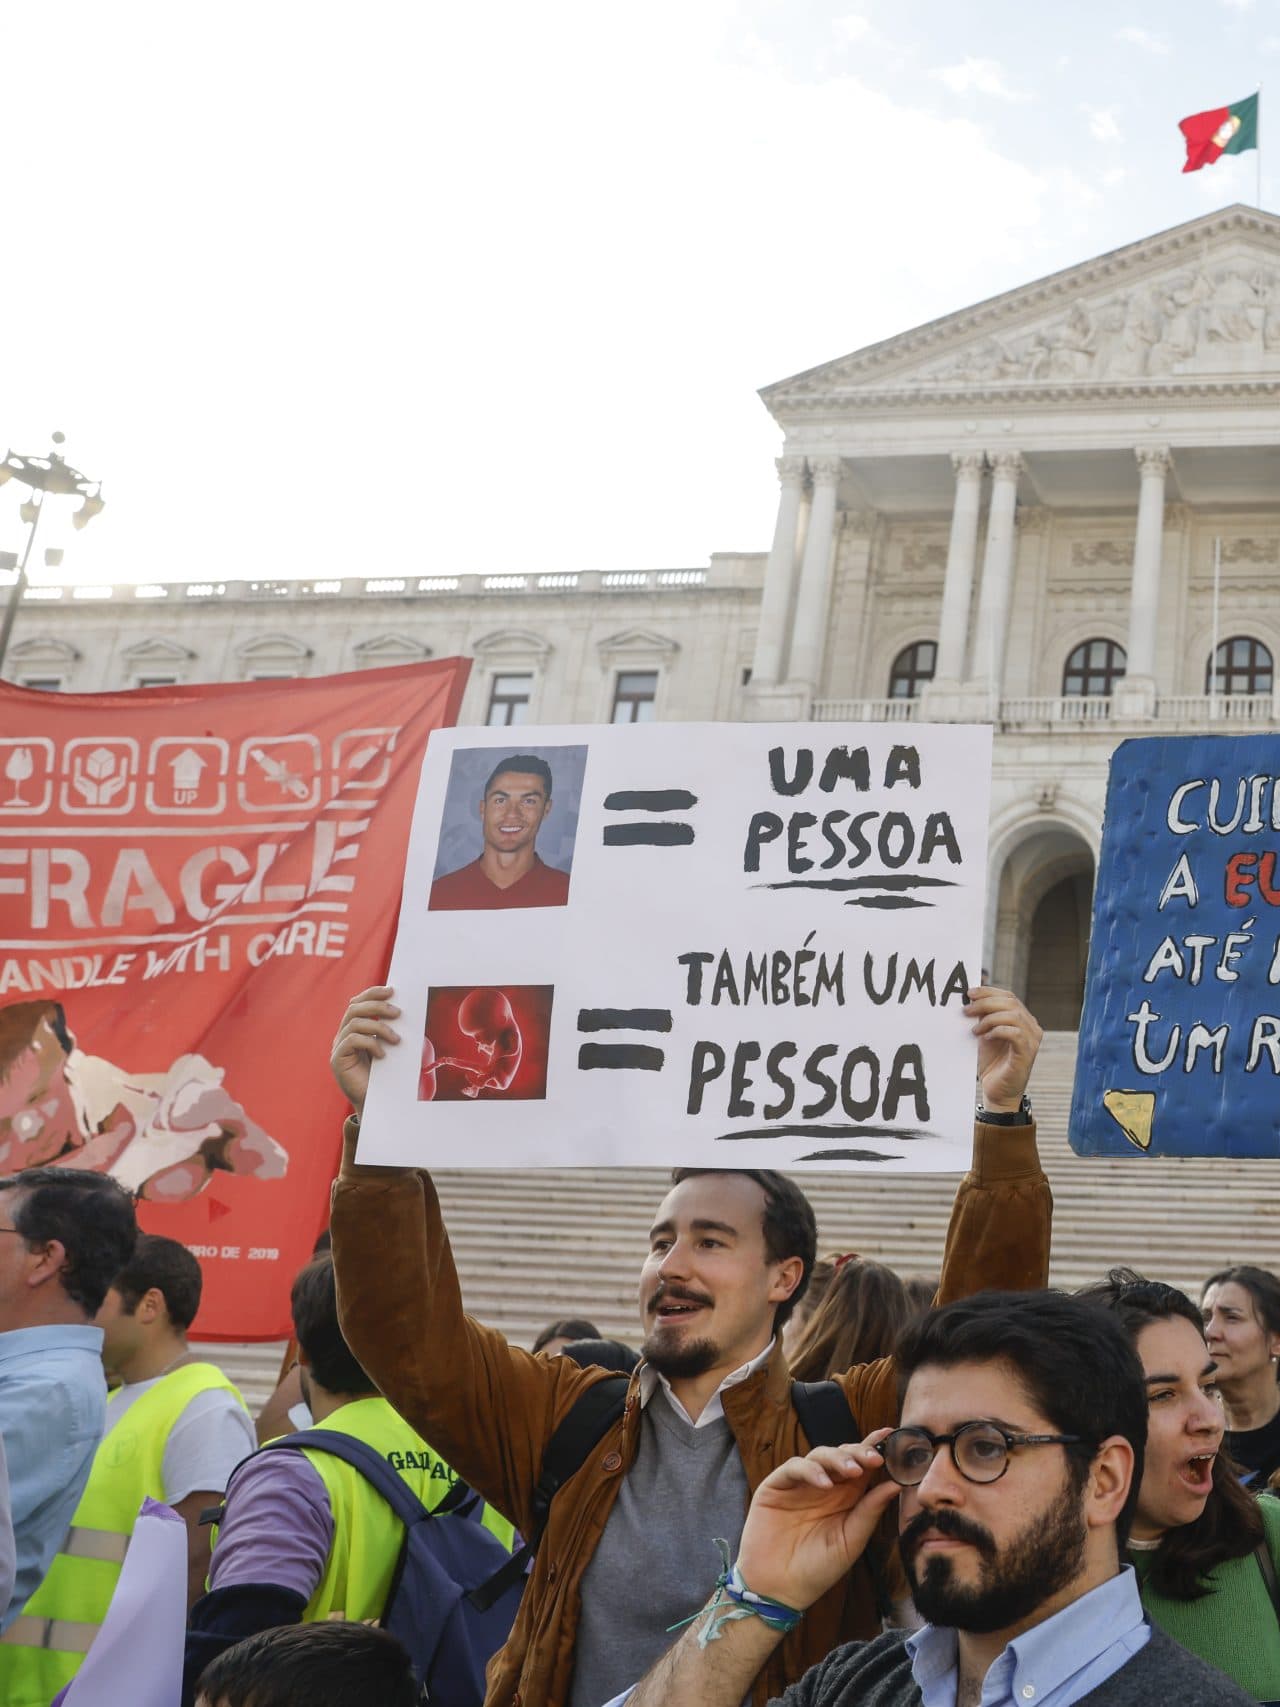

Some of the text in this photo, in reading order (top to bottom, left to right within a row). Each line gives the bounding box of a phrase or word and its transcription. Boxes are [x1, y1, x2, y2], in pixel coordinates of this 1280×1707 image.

[174, 790, 198, 805] UP
[768, 745, 920, 796] UMA
[744, 810, 962, 874] PESSOA
[1159, 853, 1198, 911] A
[0, 953, 136, 994] ANDLE
[247, 921, 349, 967] CARE
[678, 930, 971, 1005] TAMBÉM UMA
[1144, 916, 1257, 985] ATÉ
[1126, 1001, 1231, 1075] UM
[687, 1041, 930, 1121] PESSOA
[221, 1246, 240, 1259] DE
